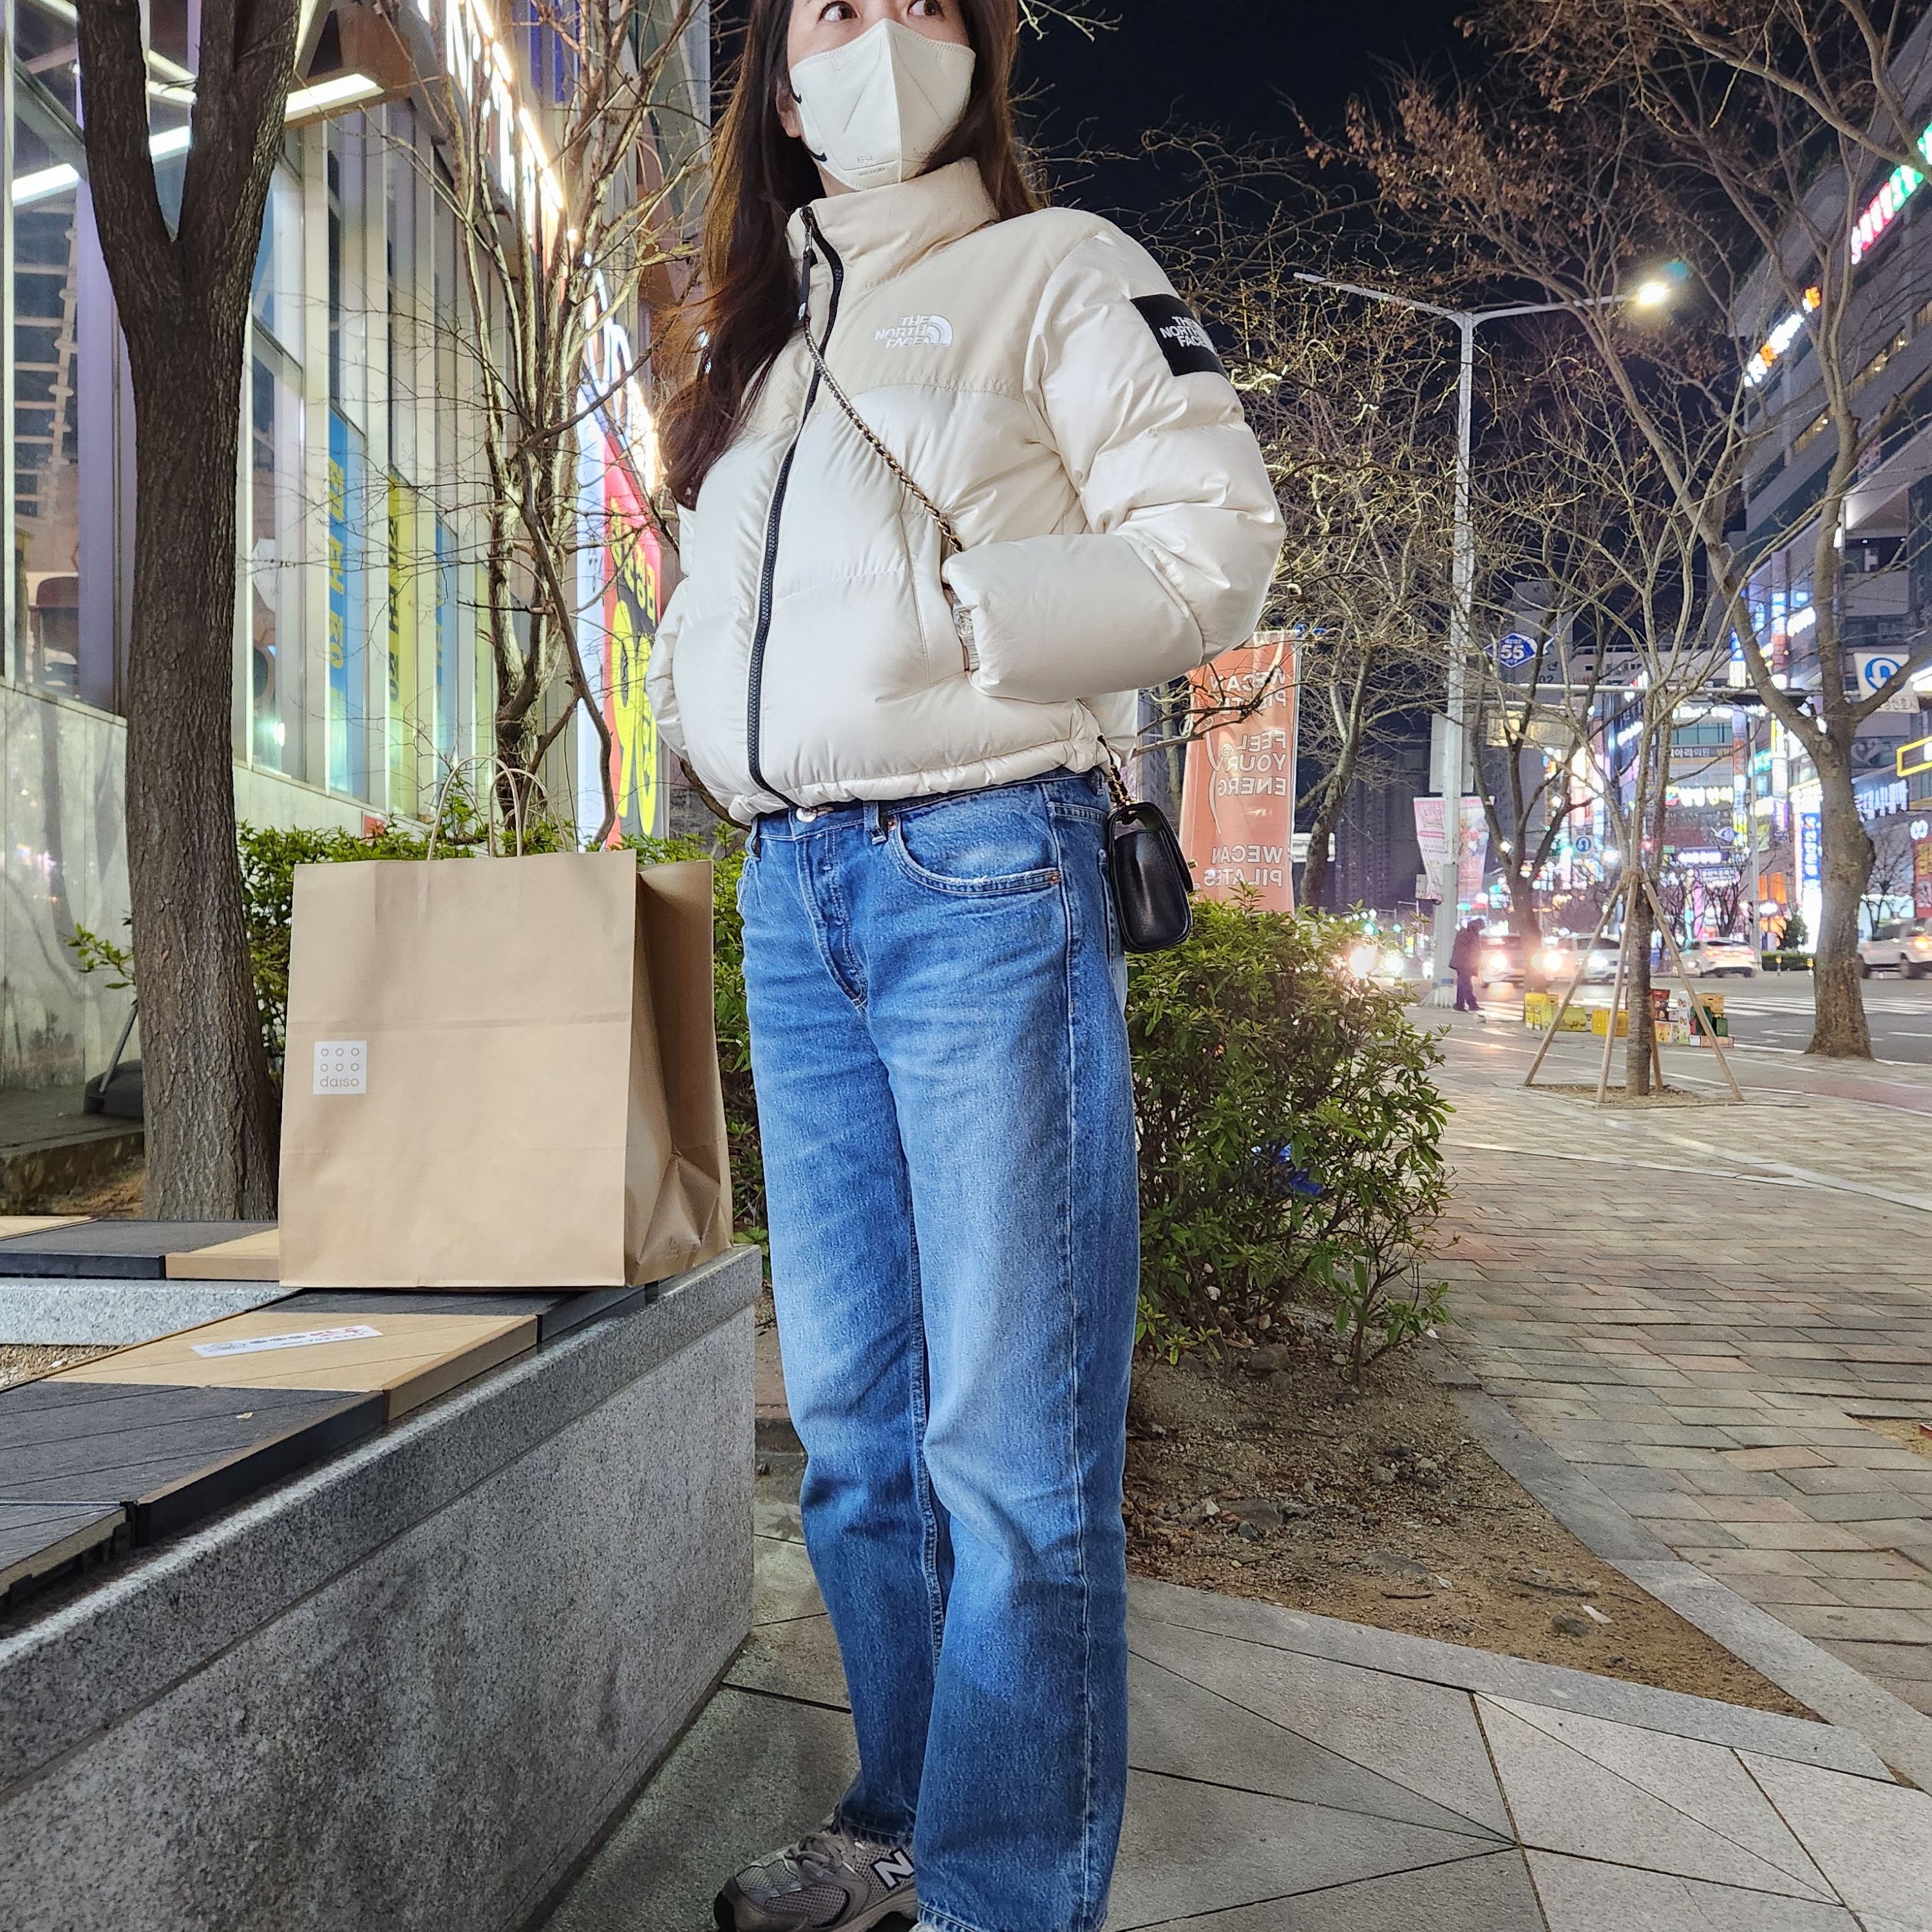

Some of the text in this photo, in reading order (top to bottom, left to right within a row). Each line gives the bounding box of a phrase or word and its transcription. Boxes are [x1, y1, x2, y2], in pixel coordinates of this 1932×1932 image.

[901, 314, 931, 326] THE
[1171, 316, 1194, 327] THE
[874, 324, 927, 341] NORTH
[1159, 326, 1201, 339] NORTH
[886, 336, 926, 350] FACE
[1177, 335, 1206, 347] FACE
[1500, 644, 1524, 659] 55
[1670, 747, 1710, 758] 아라의원
[319, 1075, 359, 1088] daiso
